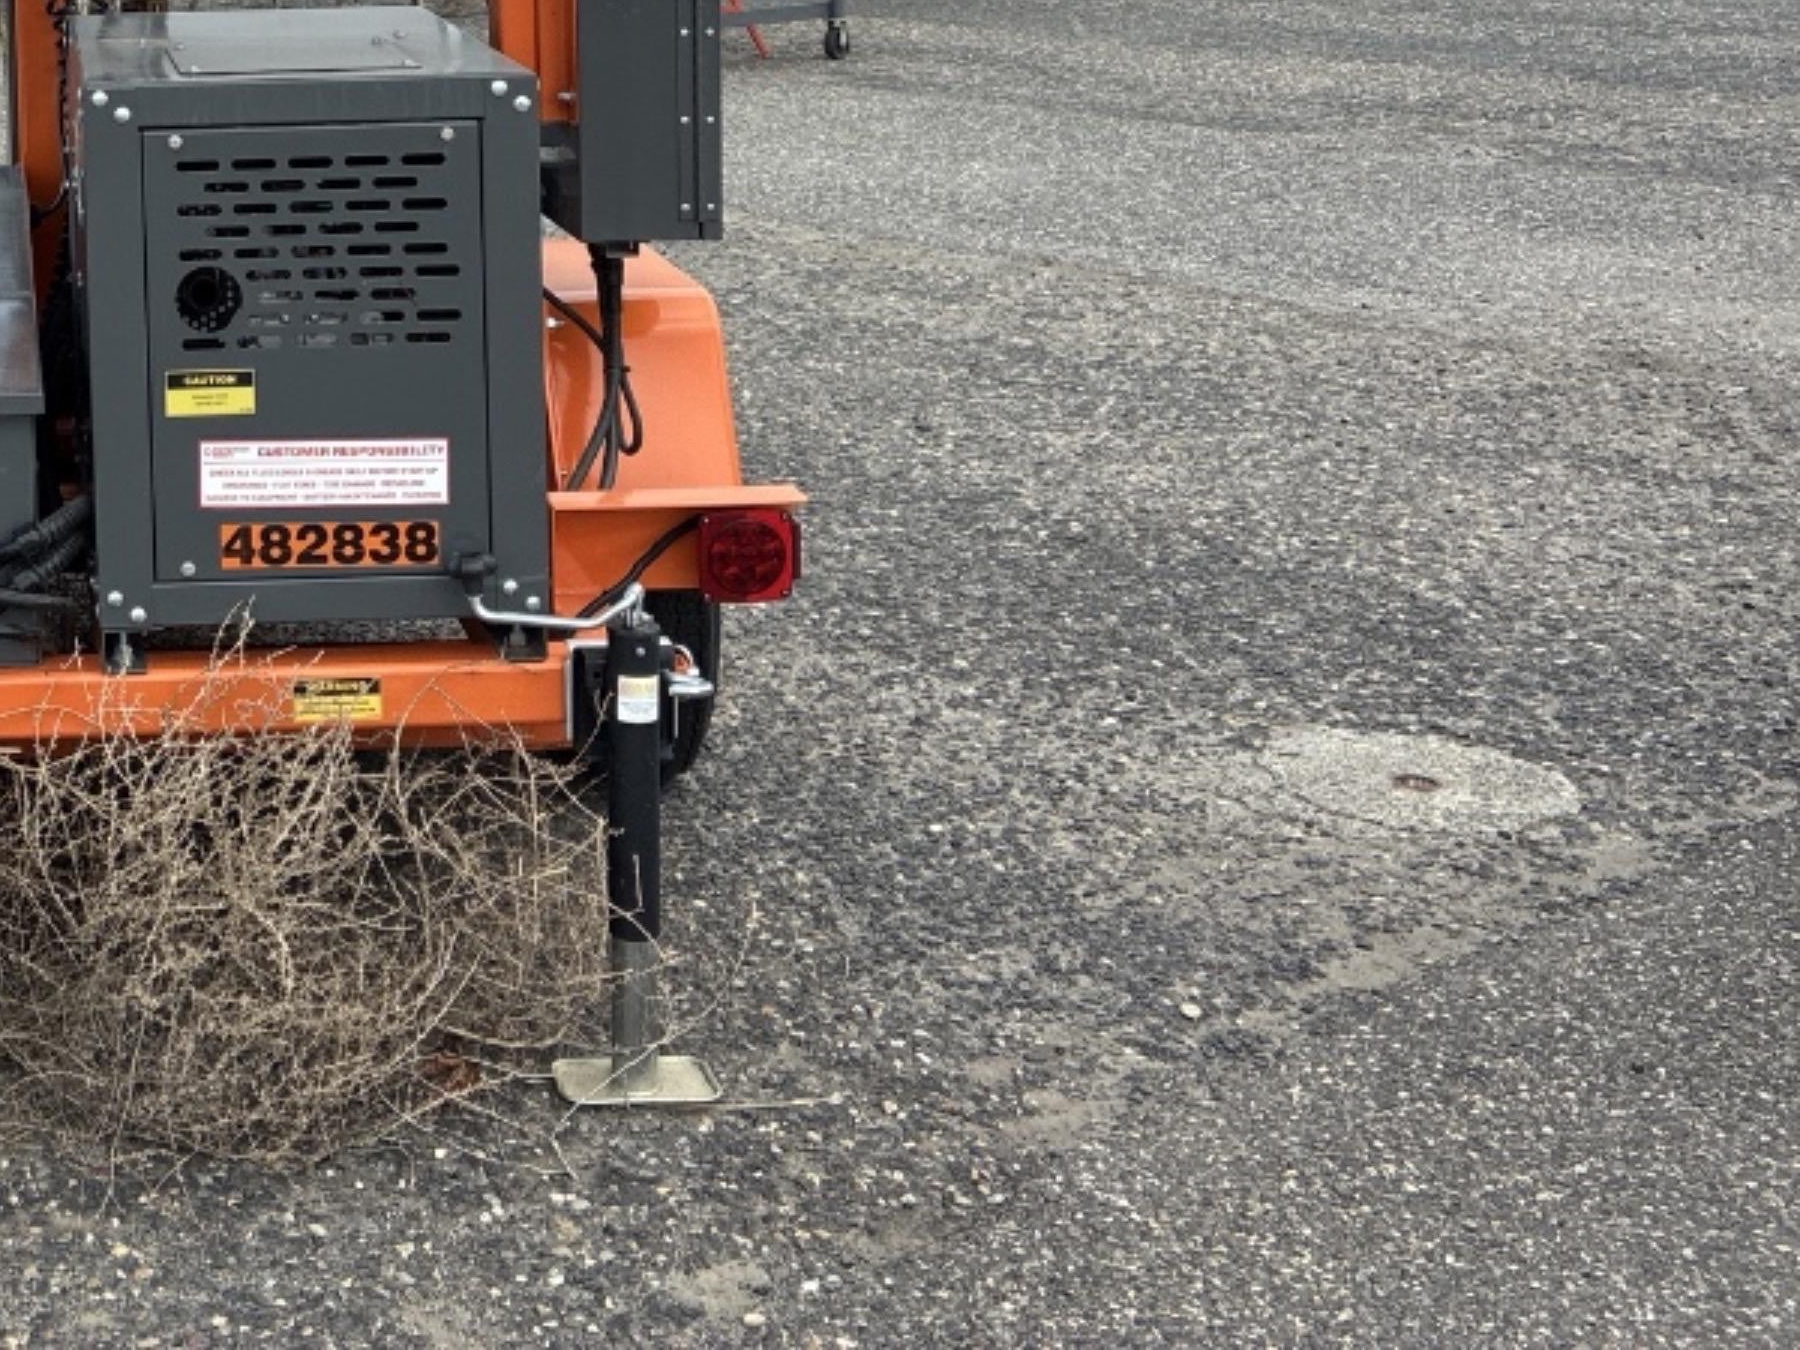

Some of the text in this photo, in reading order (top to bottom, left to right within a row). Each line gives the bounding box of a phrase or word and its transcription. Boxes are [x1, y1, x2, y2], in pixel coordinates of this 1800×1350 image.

[183, 374, 238, 387] CAUTION
[257, 446, 331, 458] CUSTOMER
[222, 521, 438, 566] 482838
